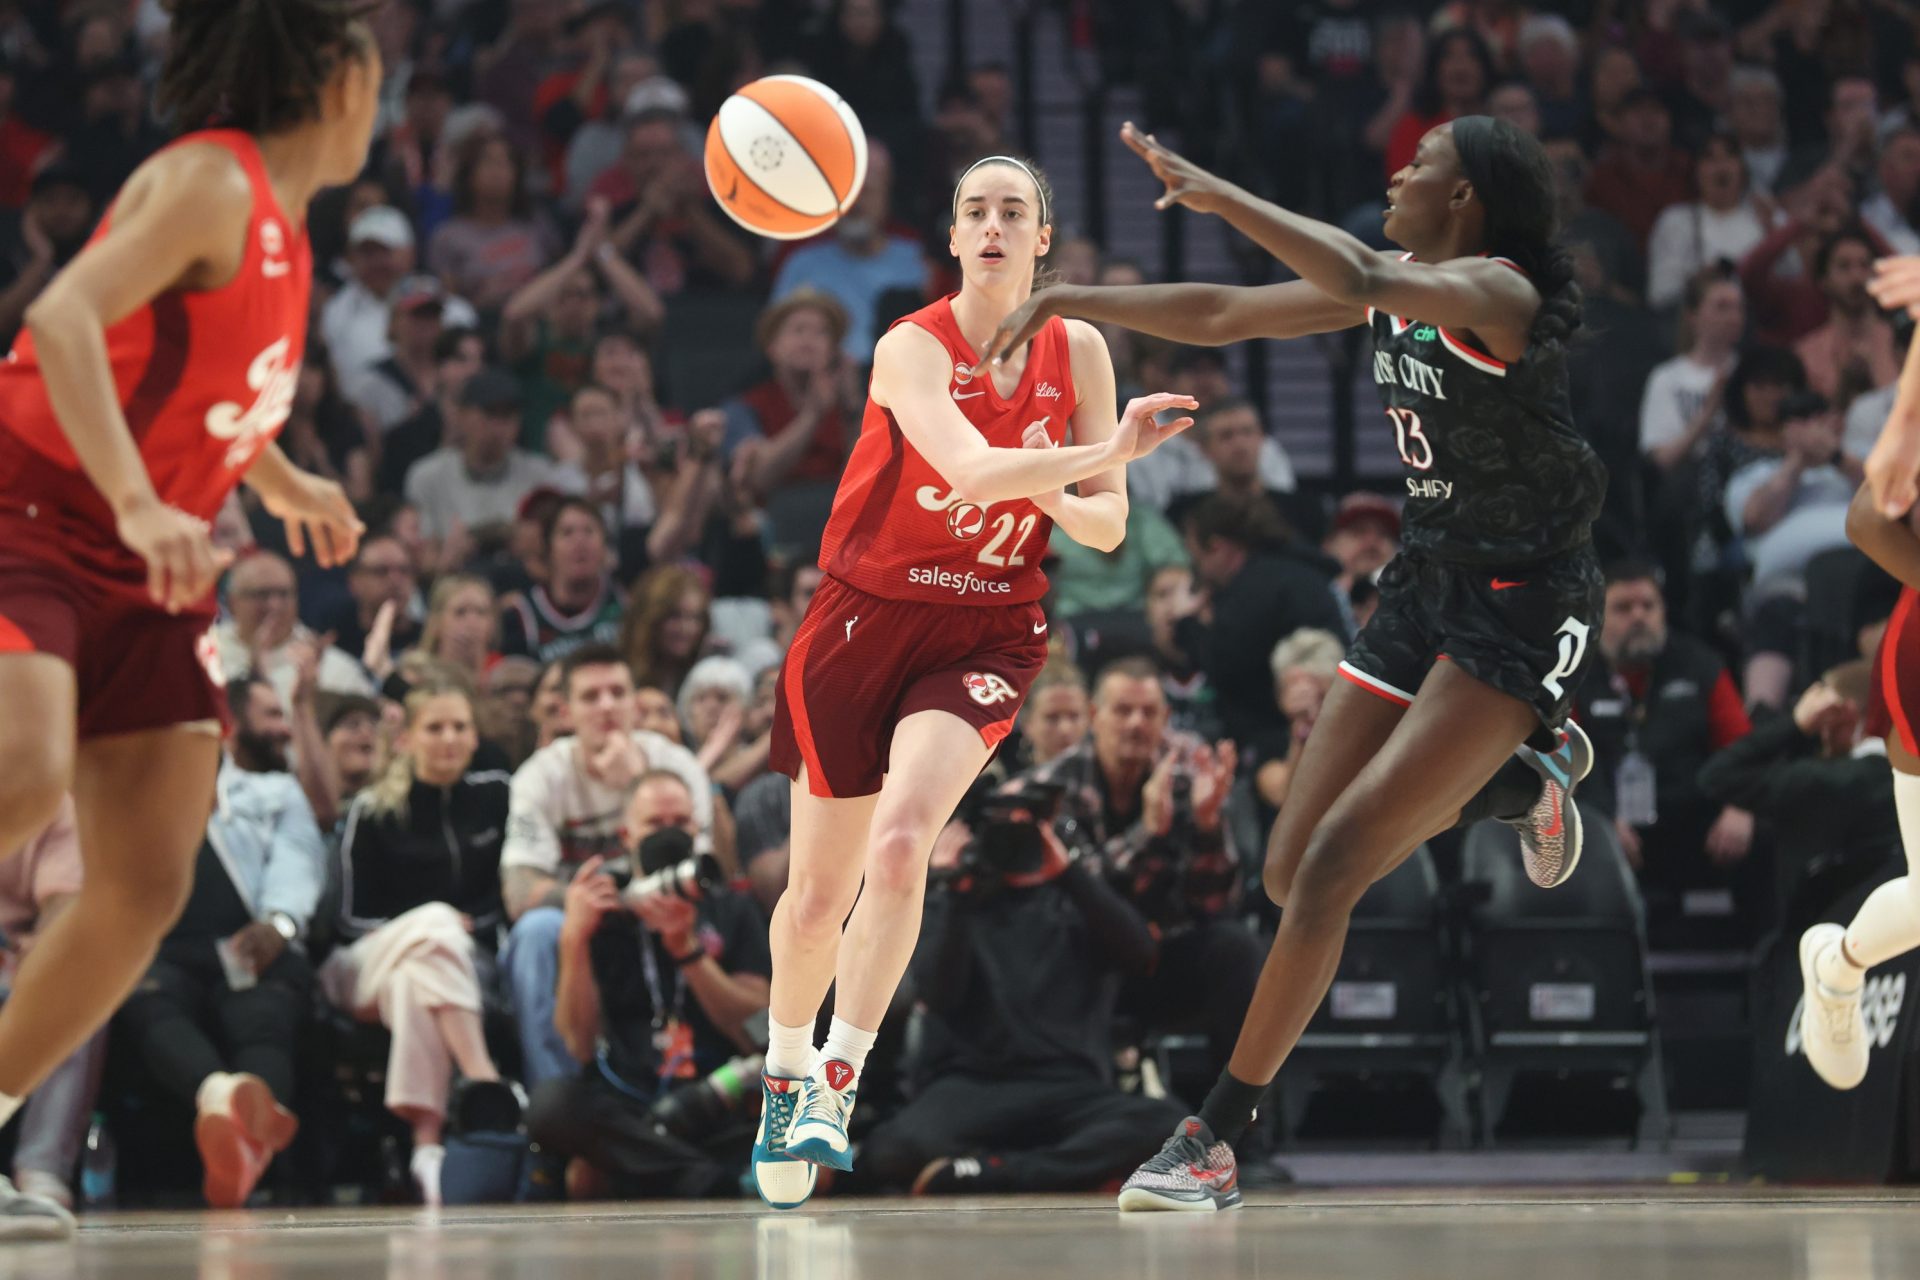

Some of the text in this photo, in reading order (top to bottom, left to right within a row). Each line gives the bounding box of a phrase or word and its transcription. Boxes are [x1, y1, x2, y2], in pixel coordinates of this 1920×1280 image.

[1036, 382, 1062, 401] Lilly
[1399, 353, 1448, 400] CITY
[1384, 406, 1433, 470] 13
[976, 512, 1037, 568] 22
[908, 566, 1011, 595] salesforce
